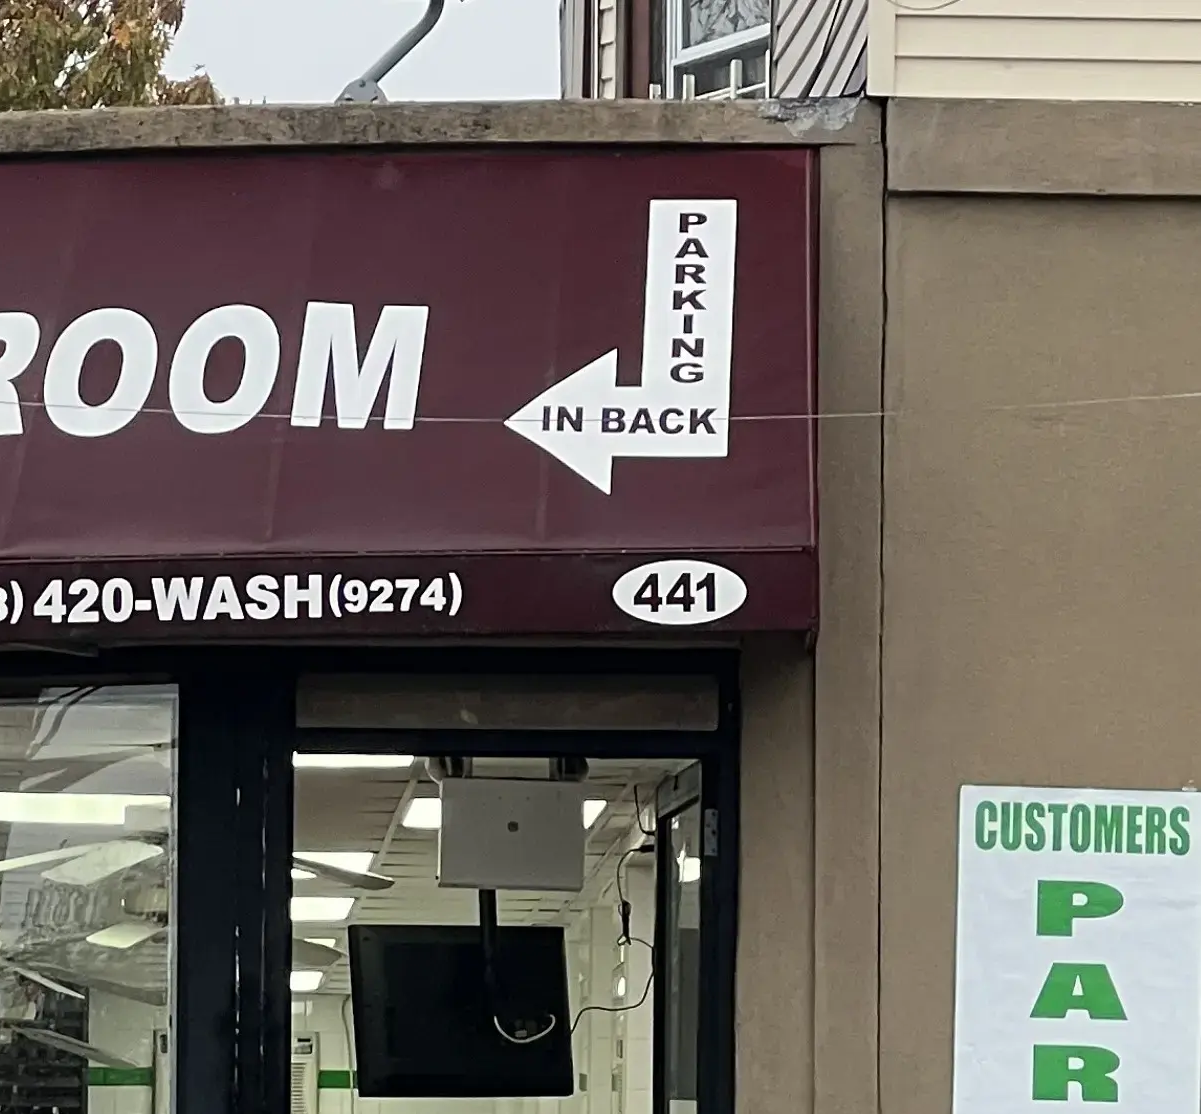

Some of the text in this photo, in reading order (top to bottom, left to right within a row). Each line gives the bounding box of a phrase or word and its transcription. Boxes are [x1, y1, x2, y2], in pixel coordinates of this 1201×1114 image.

[670, 212, 709, 384] PARKING
[541, 405, 718, 435] IN BACK
[33, 575, 322, 622] 420-WASH
[329, 573, 462, 617] (9274)
[633, 572, 716, 612] 441
[974, 800, 1191, 855] CUSTOMERS
